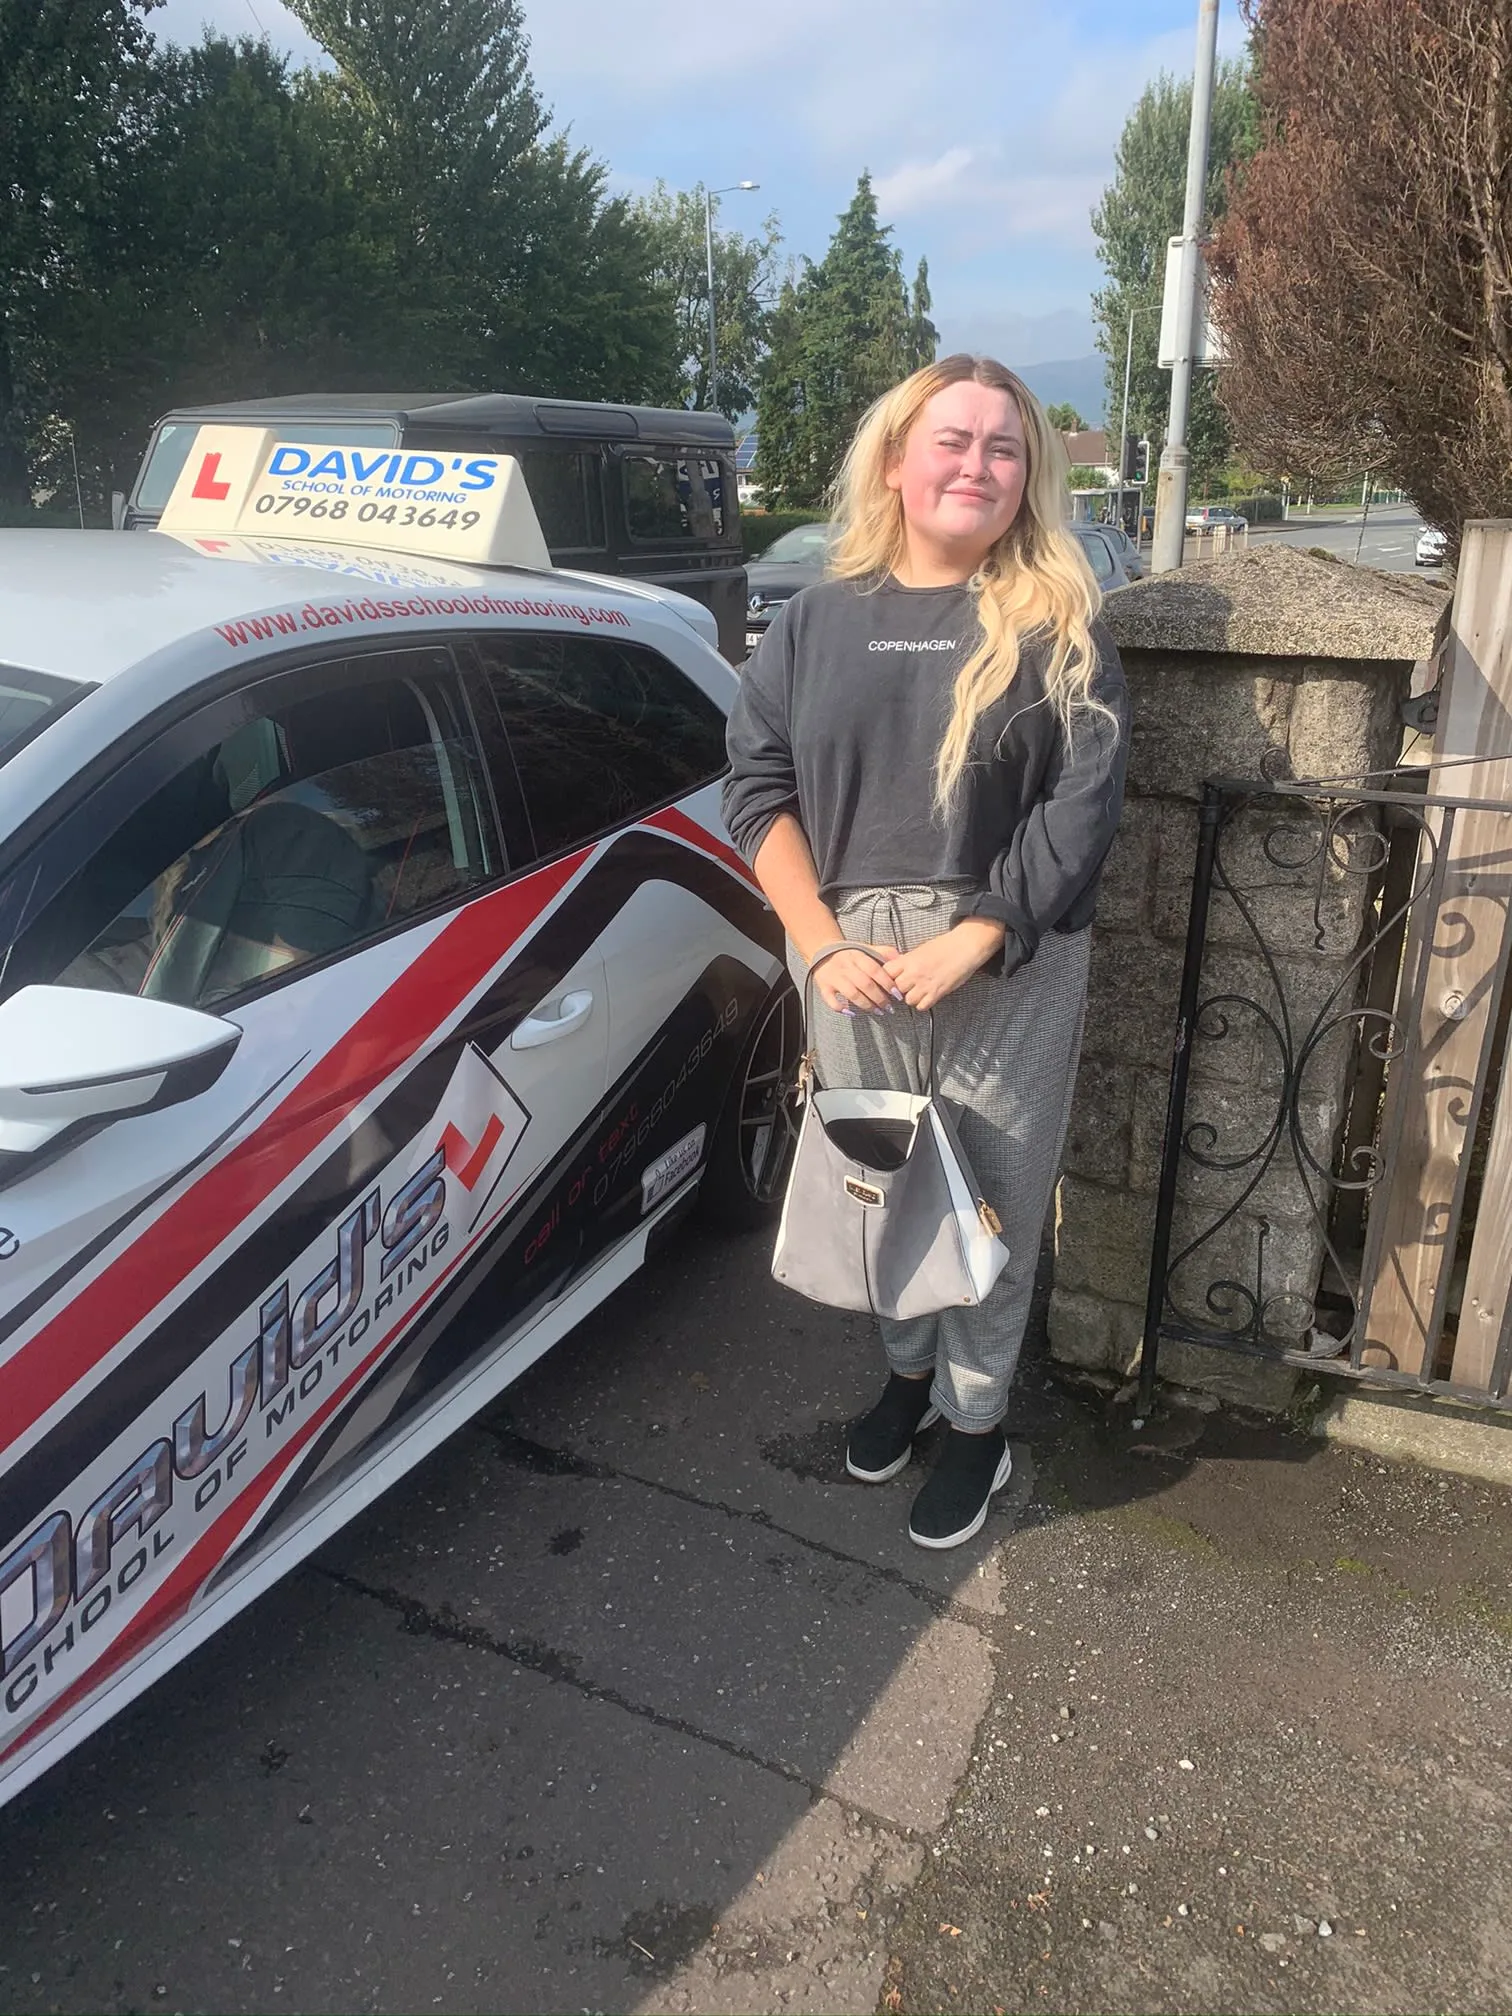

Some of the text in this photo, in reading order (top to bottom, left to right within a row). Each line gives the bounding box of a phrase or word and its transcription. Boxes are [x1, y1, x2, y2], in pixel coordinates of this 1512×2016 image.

[191, 452, 231, 501] L
[268, 447, 498, 490] DAVID'S
[281, 479, 467, 504] SCHOOL OF MOTORING
[255, 494, 481, 531] 07968 043649
[213, 594, 631, 648] www.davidsschoolofmotoring.com
[868, 640, 956, 652] COPENHAGEN
[593, 997, 738, 1206] 07968043649
[524, 1102, 638, 1265] call or text
[195, 1438, 248, 1512] OF
[266, 1222, 449, 1438] MOTORING
